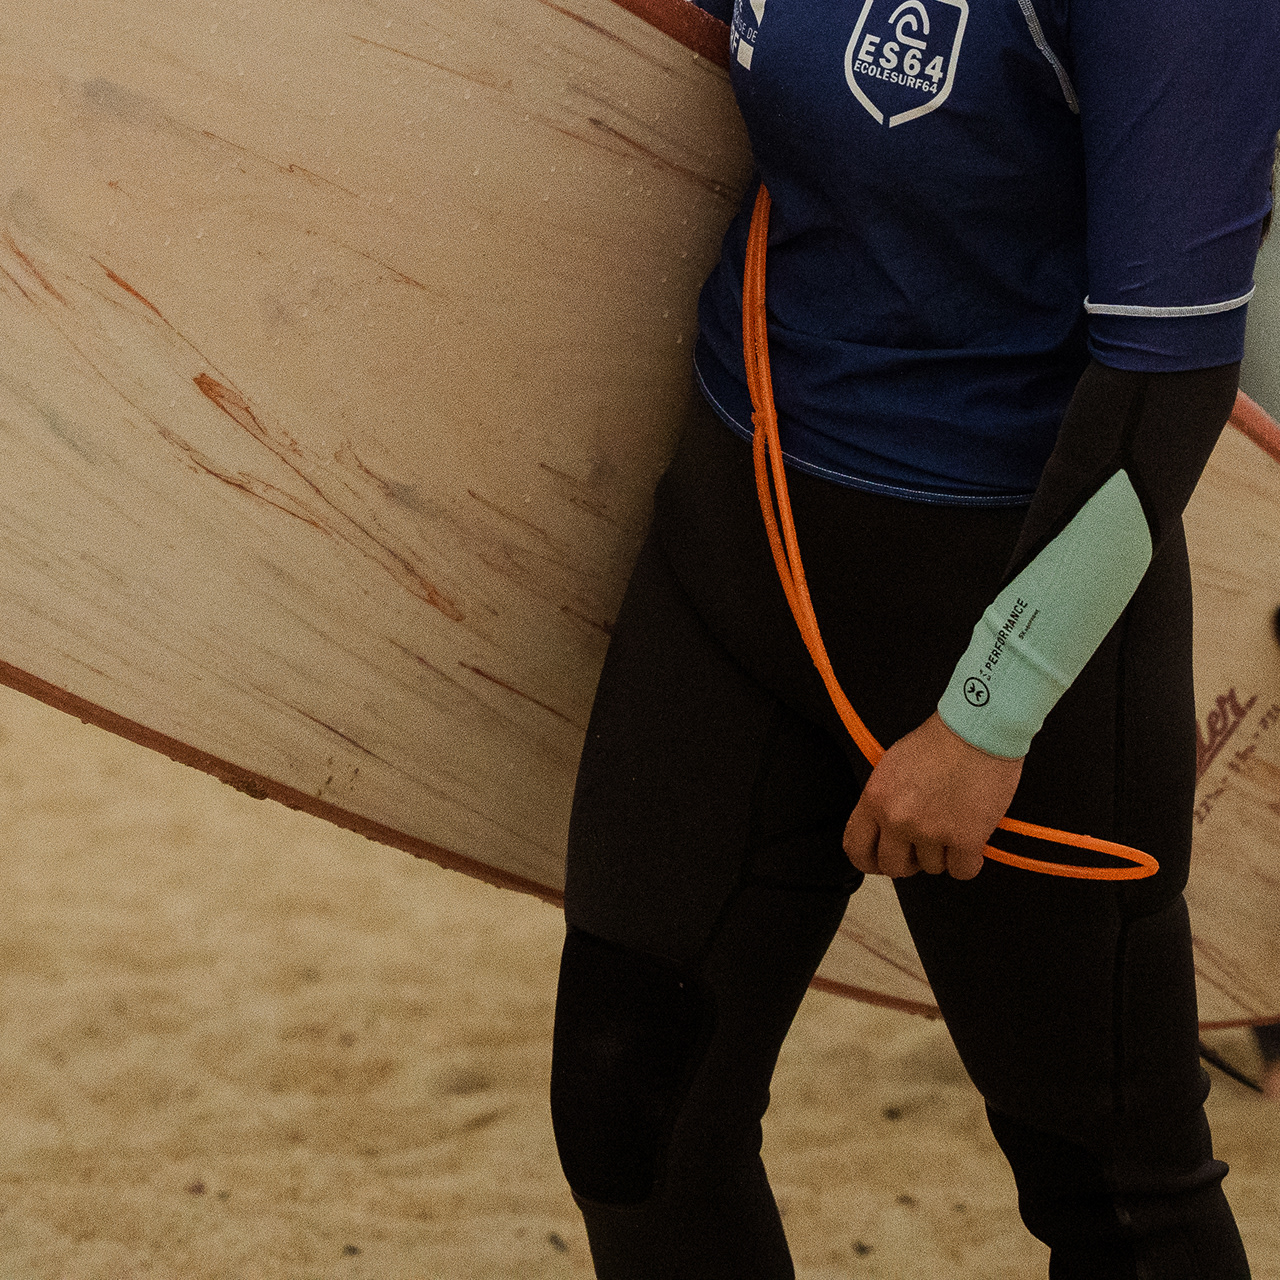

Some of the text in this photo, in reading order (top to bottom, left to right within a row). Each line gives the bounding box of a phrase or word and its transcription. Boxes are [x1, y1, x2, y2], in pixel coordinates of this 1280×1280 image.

[853, 60, 938, 94] ECOLESURF64
[857, 33, 944, 83] ES64
[984, 598, 1028, 672] PERFORMANCE
